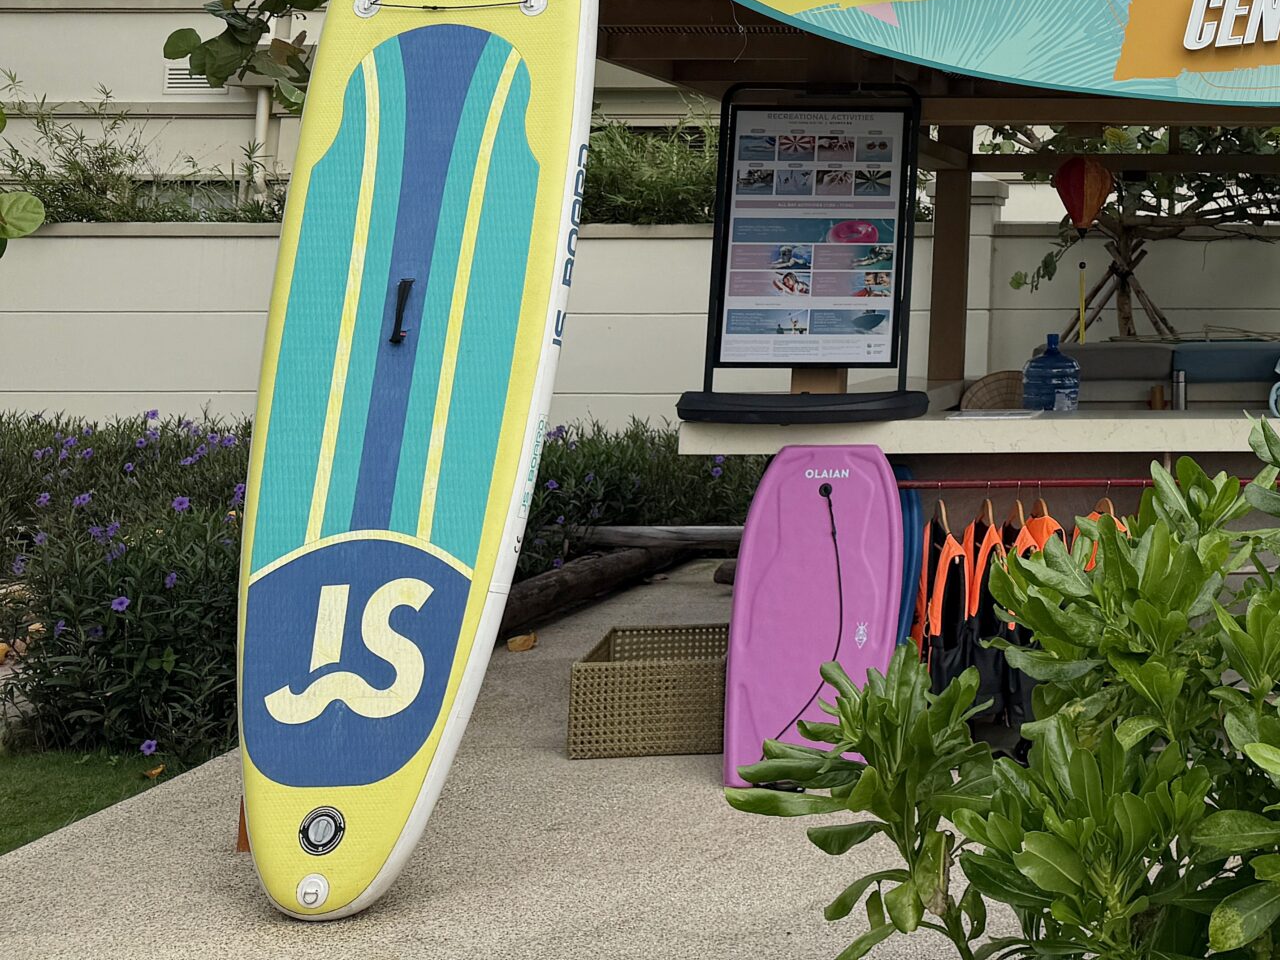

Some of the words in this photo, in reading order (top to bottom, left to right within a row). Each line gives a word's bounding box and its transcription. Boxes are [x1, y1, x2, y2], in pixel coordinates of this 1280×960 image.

[767, 112, 829, 121] RECREATIONAL
[831, 114, 875, 122] ACTIVITIES
[804, 468, 850, 479] OLAIAN
